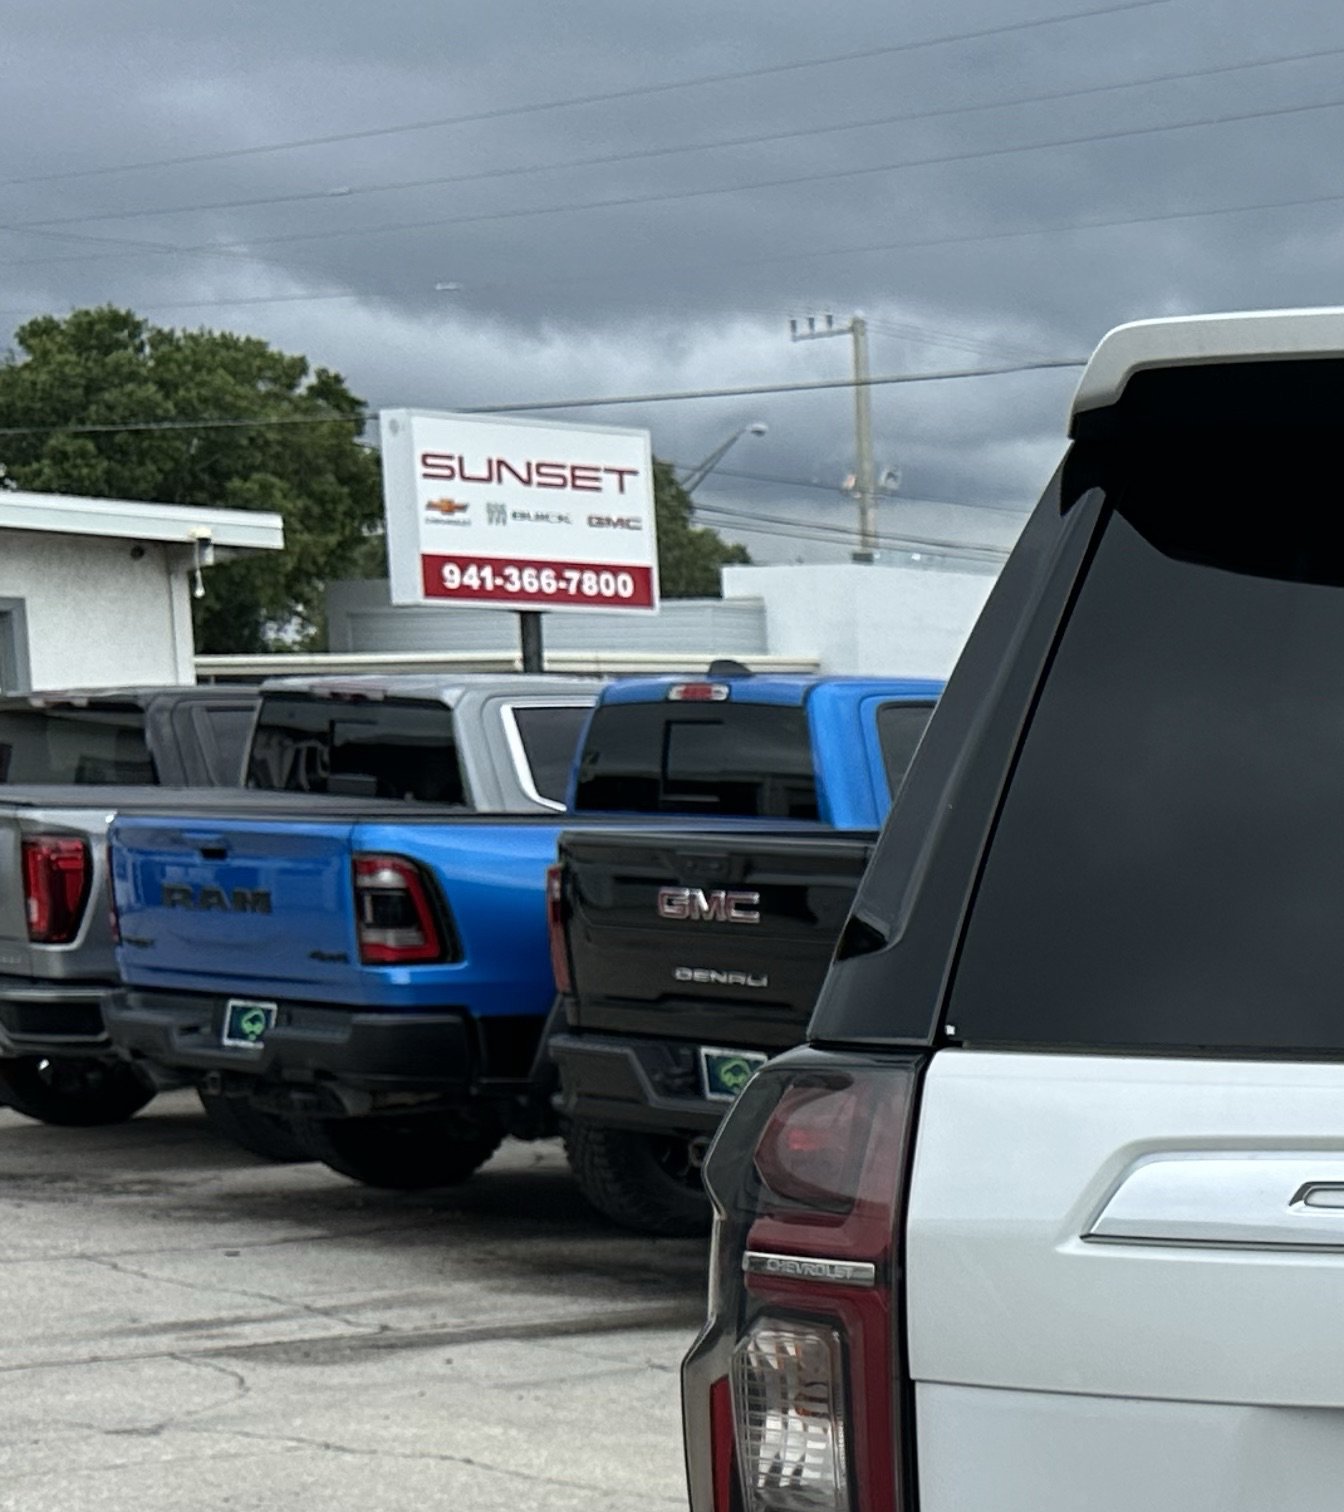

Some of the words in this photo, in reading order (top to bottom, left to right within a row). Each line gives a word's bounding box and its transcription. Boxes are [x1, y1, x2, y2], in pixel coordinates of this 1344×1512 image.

[421, 453, 639, 493] SUNSET
[587, 514, 643, 531] GMC
[442, 563, 634, 598] 941-366-7800
[161, 882, 272, 915] RAM
[658, 886, 761, 924] GMC
[674, 966, 769, 988] DENALI
[766, 1258, 854, 1280] CHEVROLET
